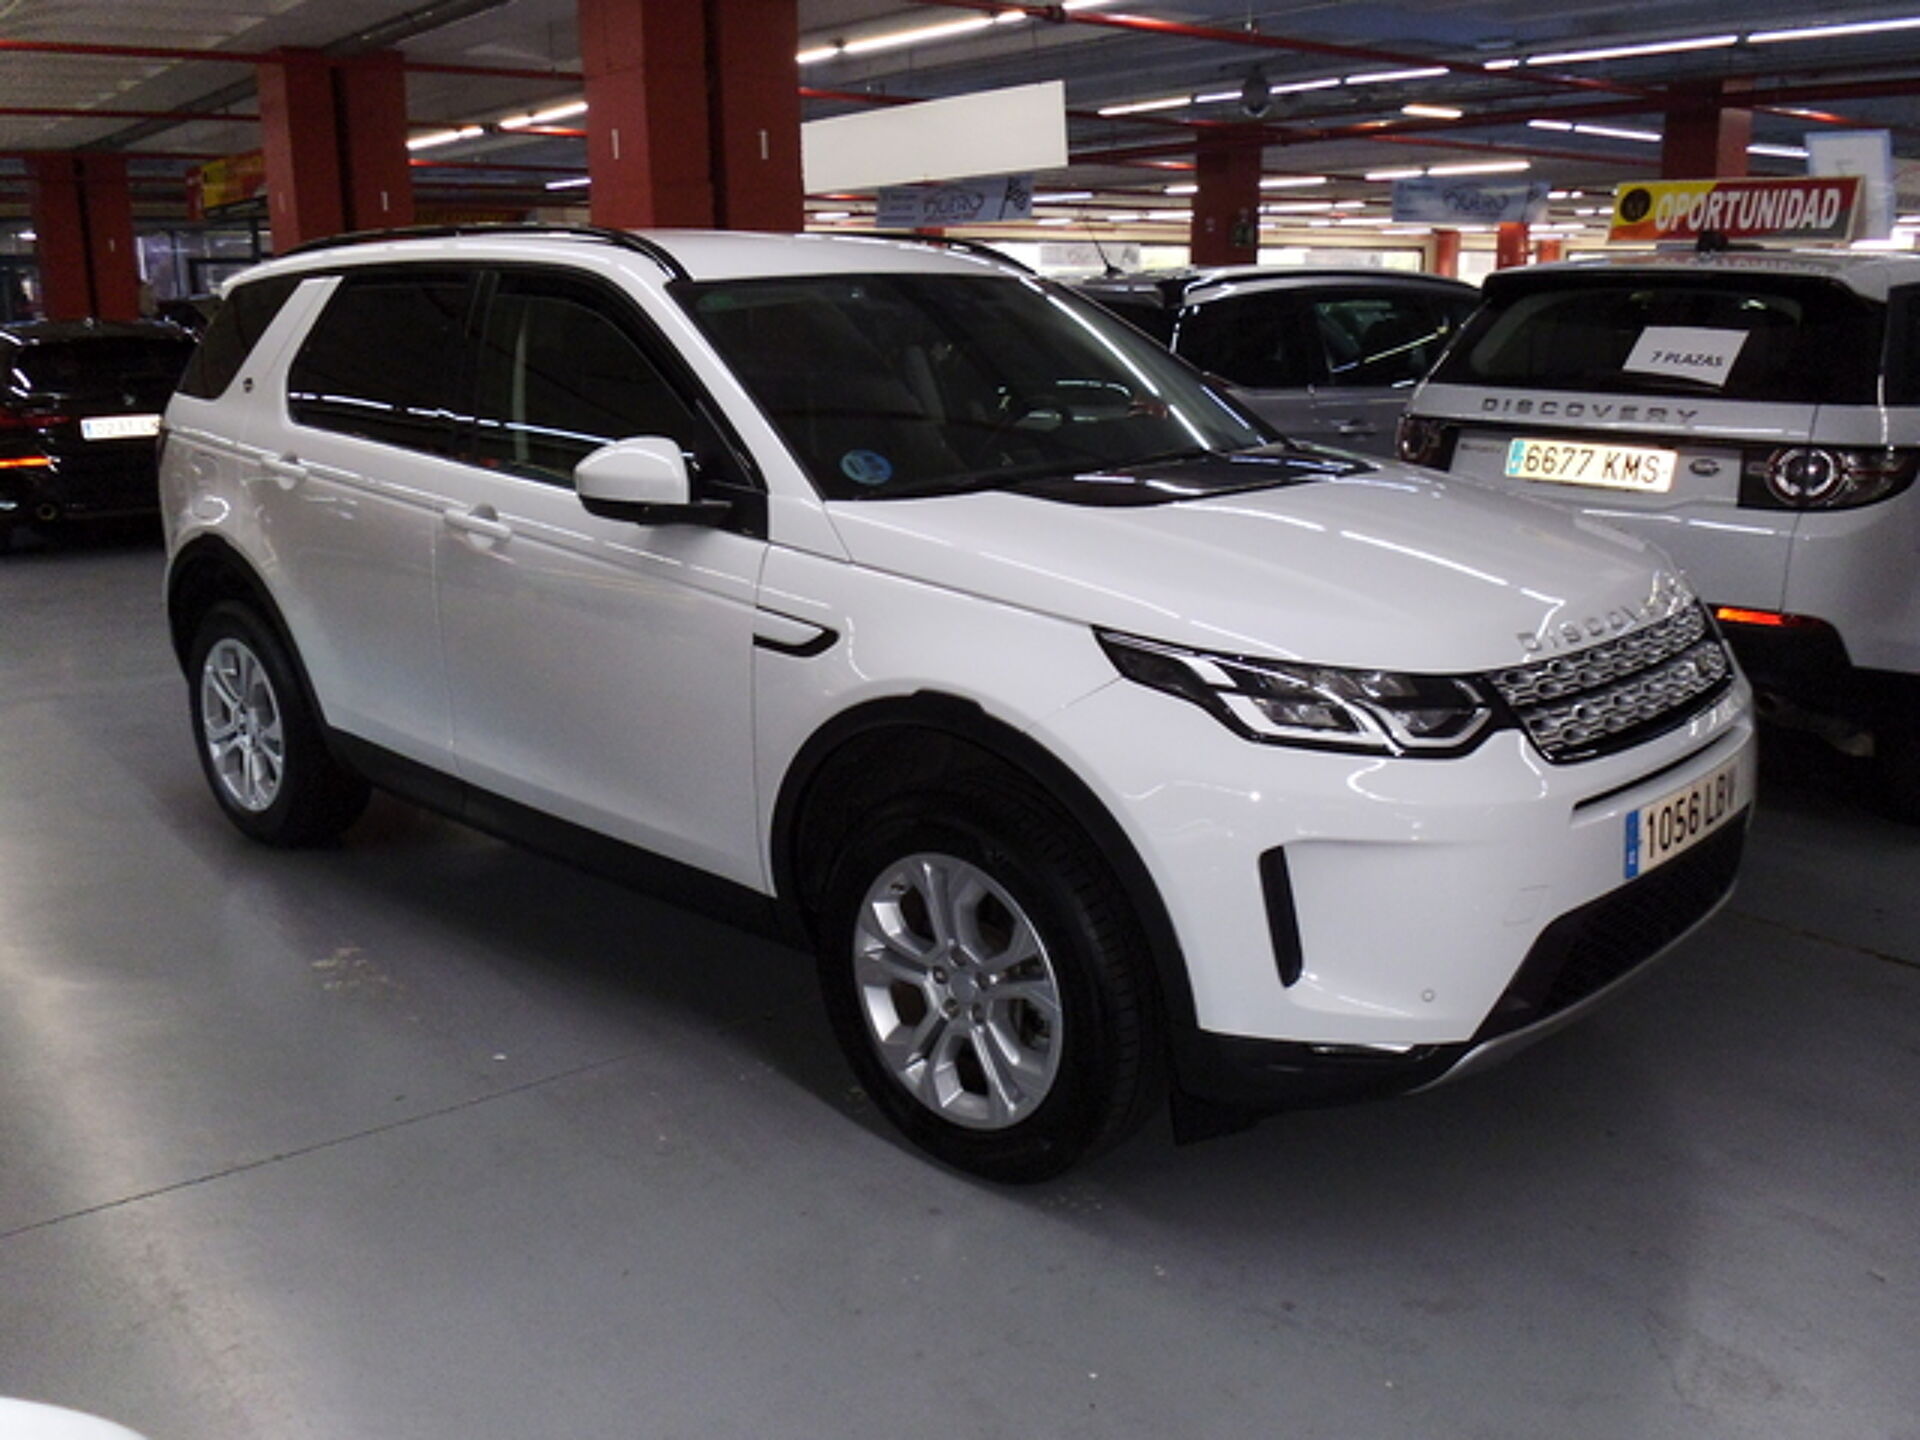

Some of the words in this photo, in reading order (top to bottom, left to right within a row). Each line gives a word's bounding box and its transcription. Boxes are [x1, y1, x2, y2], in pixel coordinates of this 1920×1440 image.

[1655, 188, 1840, 231] OPORTUNIDAD
[1651, 350, 1662, 362] 7
[1664, 352, 1723, 367] PLAZAS
[1482, 398, 1698, 423] DISCOVERY
[1524, 445, 1595, 477] 6677
[1601, 452, 1660, 484] KMS
[1648, 791, 1699, 859] 1056
